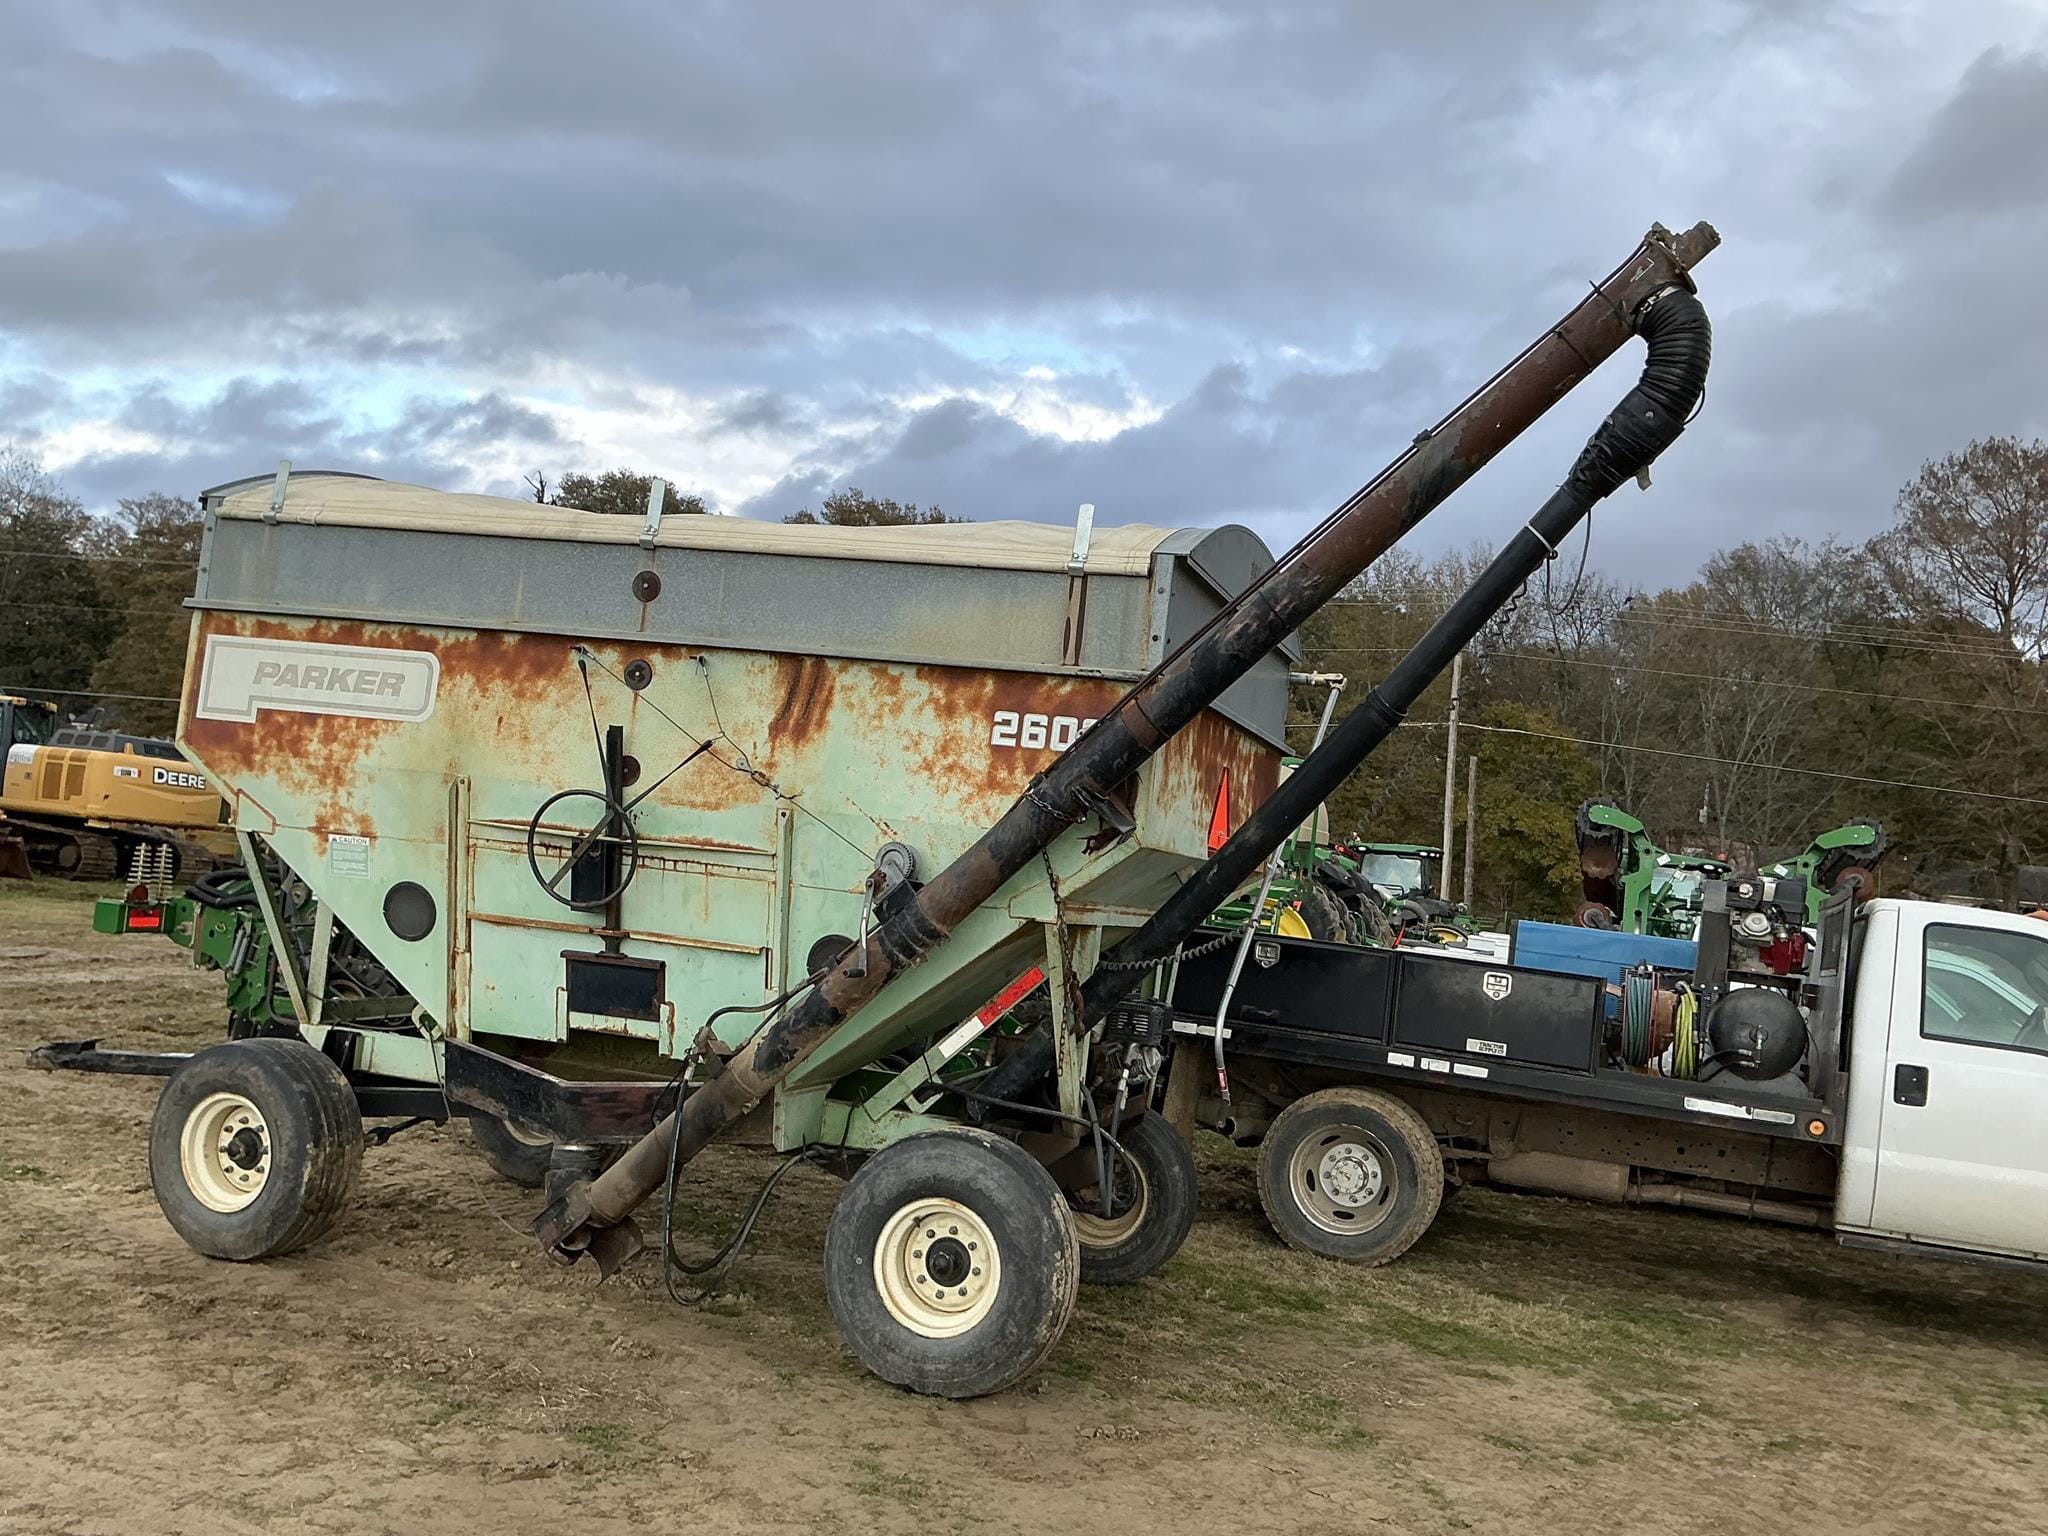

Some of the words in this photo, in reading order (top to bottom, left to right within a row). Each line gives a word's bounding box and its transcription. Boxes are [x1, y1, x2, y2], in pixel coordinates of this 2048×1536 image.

[253, 661, 405, 697] PARKER
[991, 710, 1099, 752] 260
[153, 766, 206, 790] DEERE
[339, 836, 367, 845] CAUTION
[1479, 1042, 1504, 1050] TRACTOR
